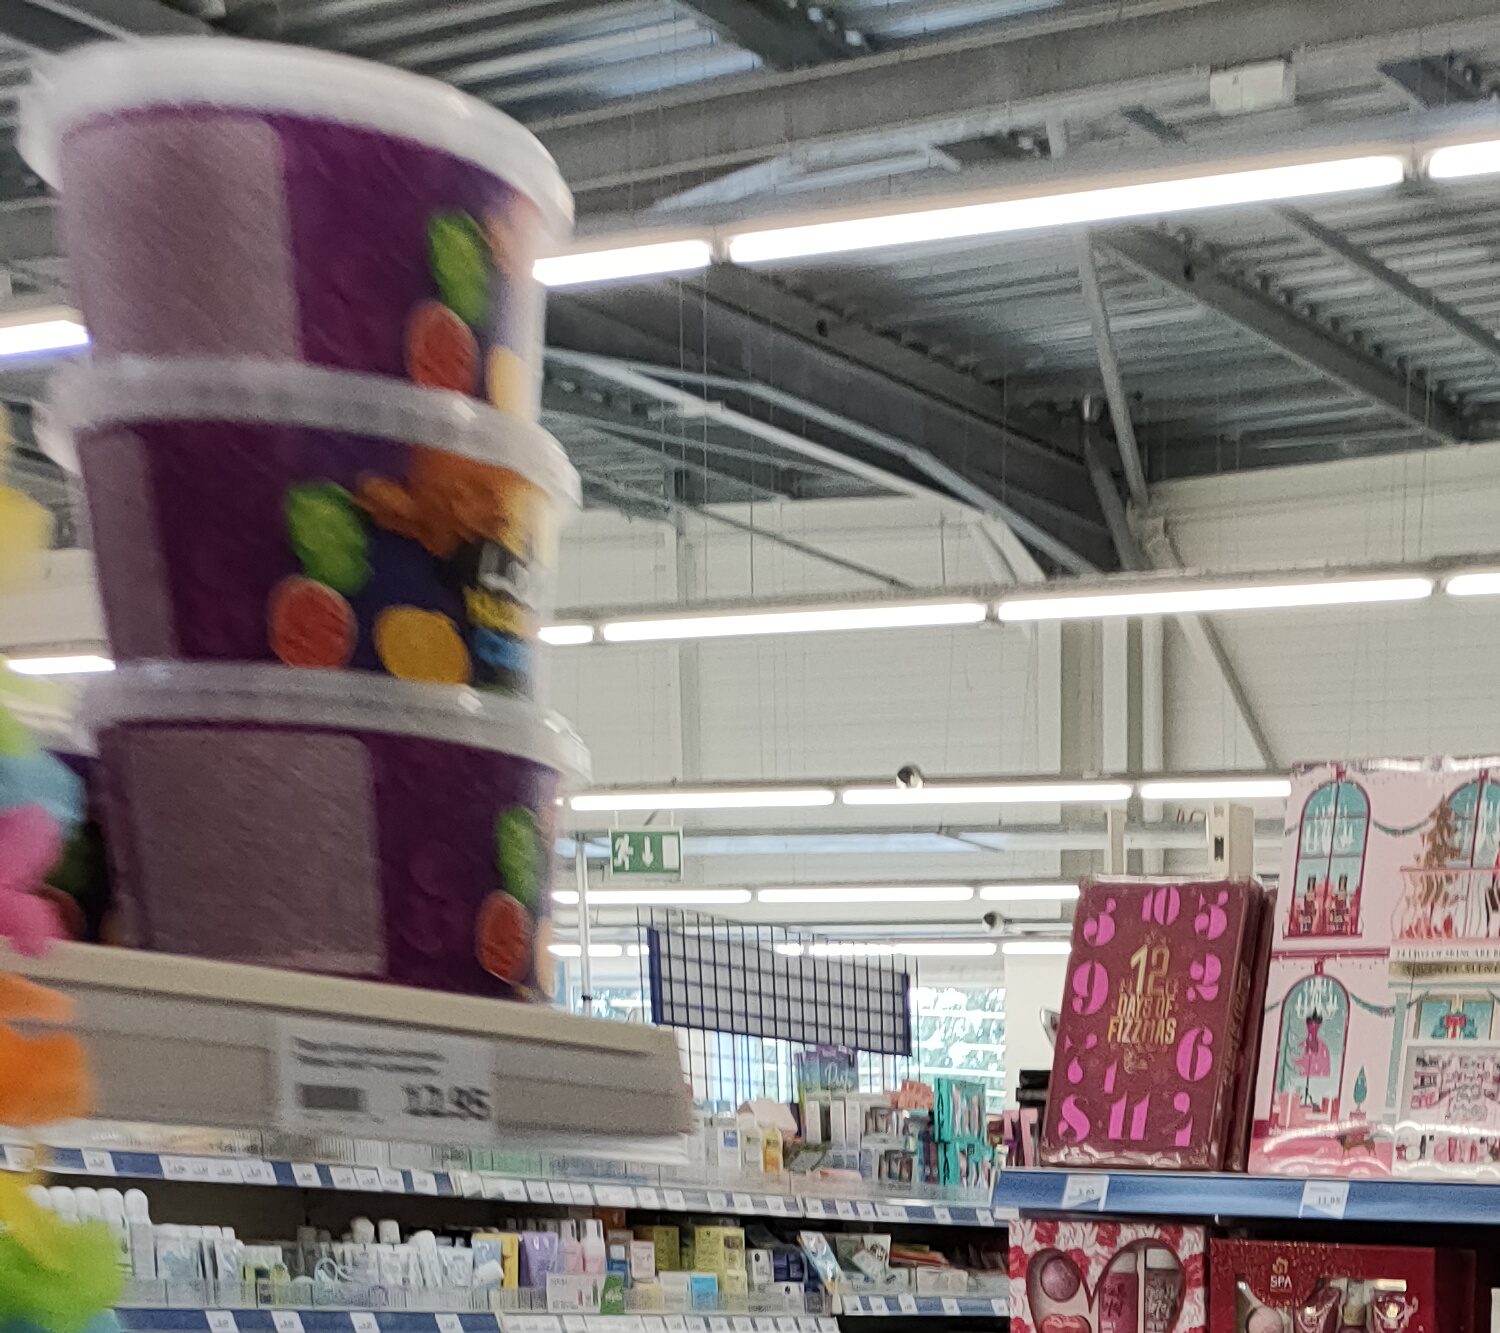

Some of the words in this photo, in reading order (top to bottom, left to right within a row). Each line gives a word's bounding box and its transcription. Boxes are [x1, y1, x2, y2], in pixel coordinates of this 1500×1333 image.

[1141, 886, 1181, 926] 10
[1072, 960, 1109, 1016] 9
[1130, 944, 1171, 1000] 12
[1116, 993, 1151, 1019] DAYS
[1154, 994, 1176, 1019] OF
[1107, 1017, 1178, 1045] FIZZMAS
[1176, 1026, 1213, 1082] 6
[1108, 1090, 1151, 1141] 11
[1271, 1274, 1293, 1290] SPA
